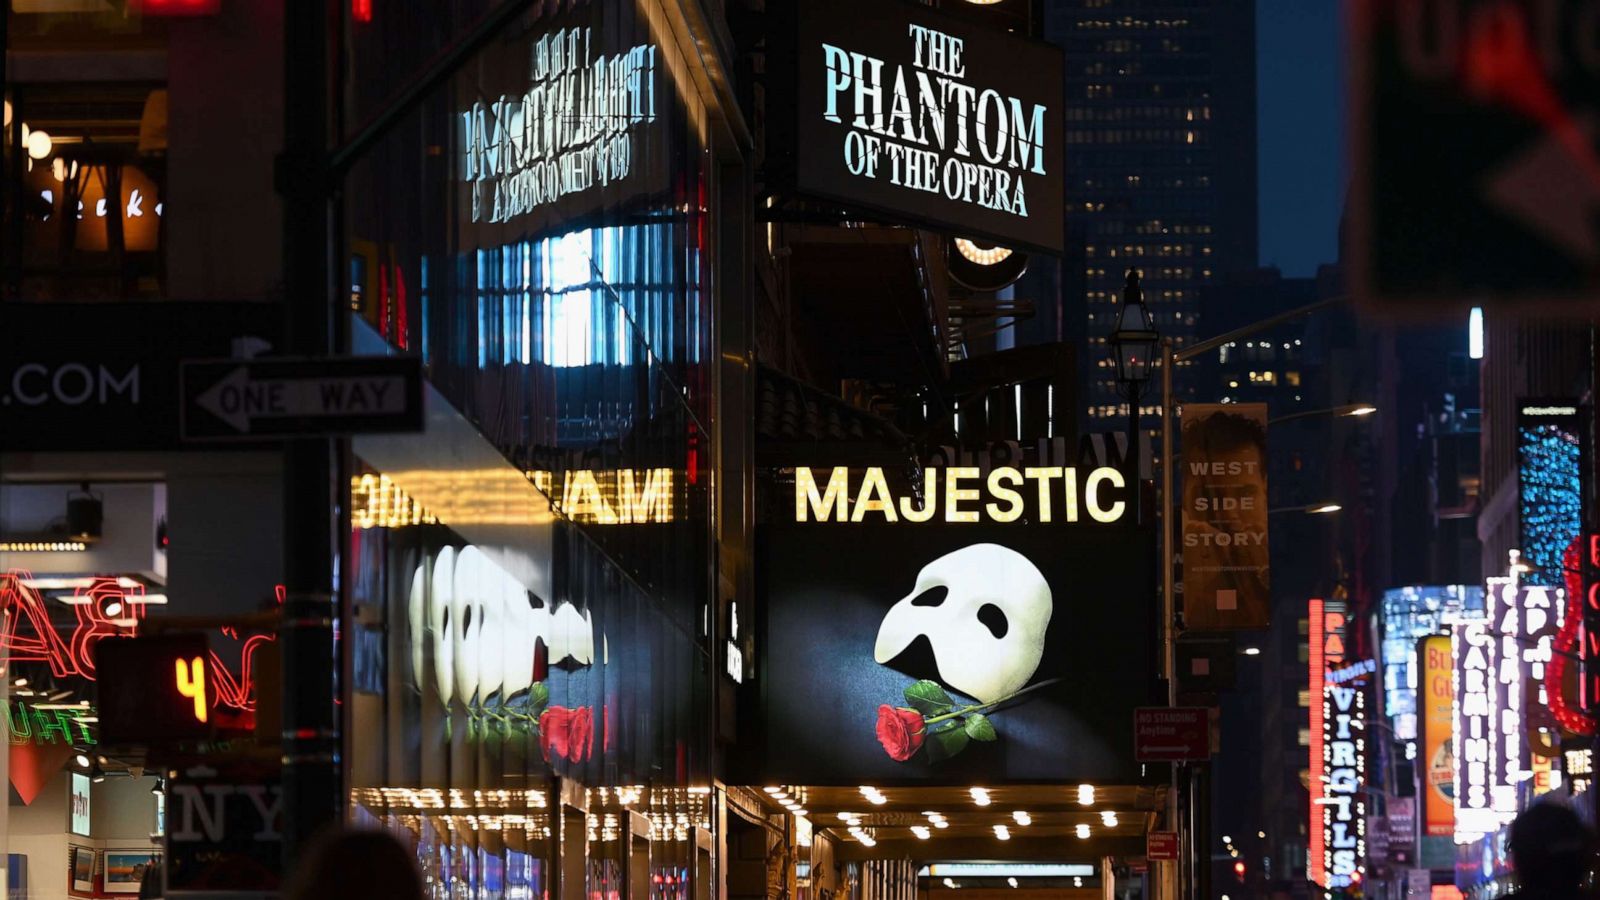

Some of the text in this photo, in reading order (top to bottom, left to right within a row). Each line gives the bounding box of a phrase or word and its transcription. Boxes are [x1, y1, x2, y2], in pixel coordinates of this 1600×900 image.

[909, 23, 965, 78] THE
[822, 43, 1047, 175] PHANTOM
[844, 130, 1028, 217] OF THE OPERA
[220, 382, 391, 414] ONE WAY
[1190, 461, 1257, 476] WEST
[795, 466, 1126, 522] MAJESTIC
[1194, 497, 1255, 511] SIDE
[1184, 532, 1265, 546] STORY
[175, 656, 207, 722] 4
[1139, 712, 1197, 723] NO STANDING
[1139, 725, 1176, 737] Anytime
